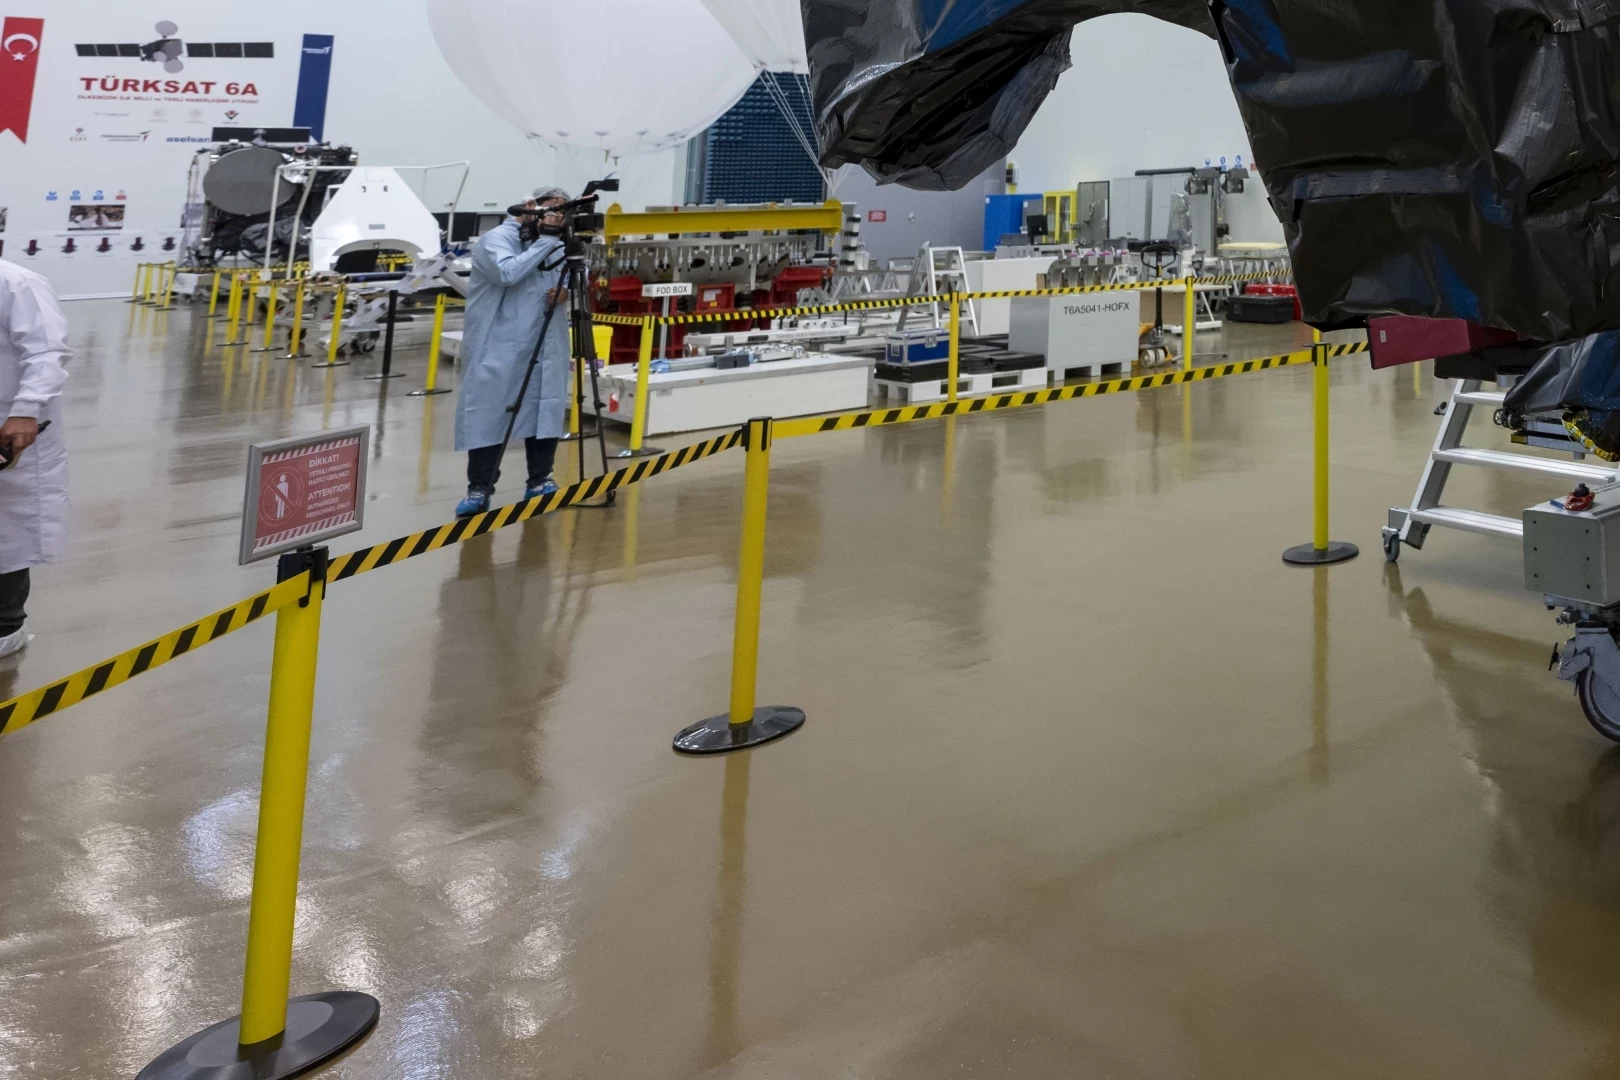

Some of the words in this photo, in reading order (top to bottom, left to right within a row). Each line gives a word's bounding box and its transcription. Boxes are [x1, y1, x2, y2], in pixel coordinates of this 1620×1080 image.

[80, 75, 217, 95] TÜRKSAT
[225, 82, 259, 96] 6A
[656, 286, 672, 295] FOD
[672, 285, 688, 294] BOX
[1063, 301, 1130, 315] T6A5041-HOFX
[309, 454, 339, 467] DİKKAT!
[308, 482, 352, 500] ATTENTION!
